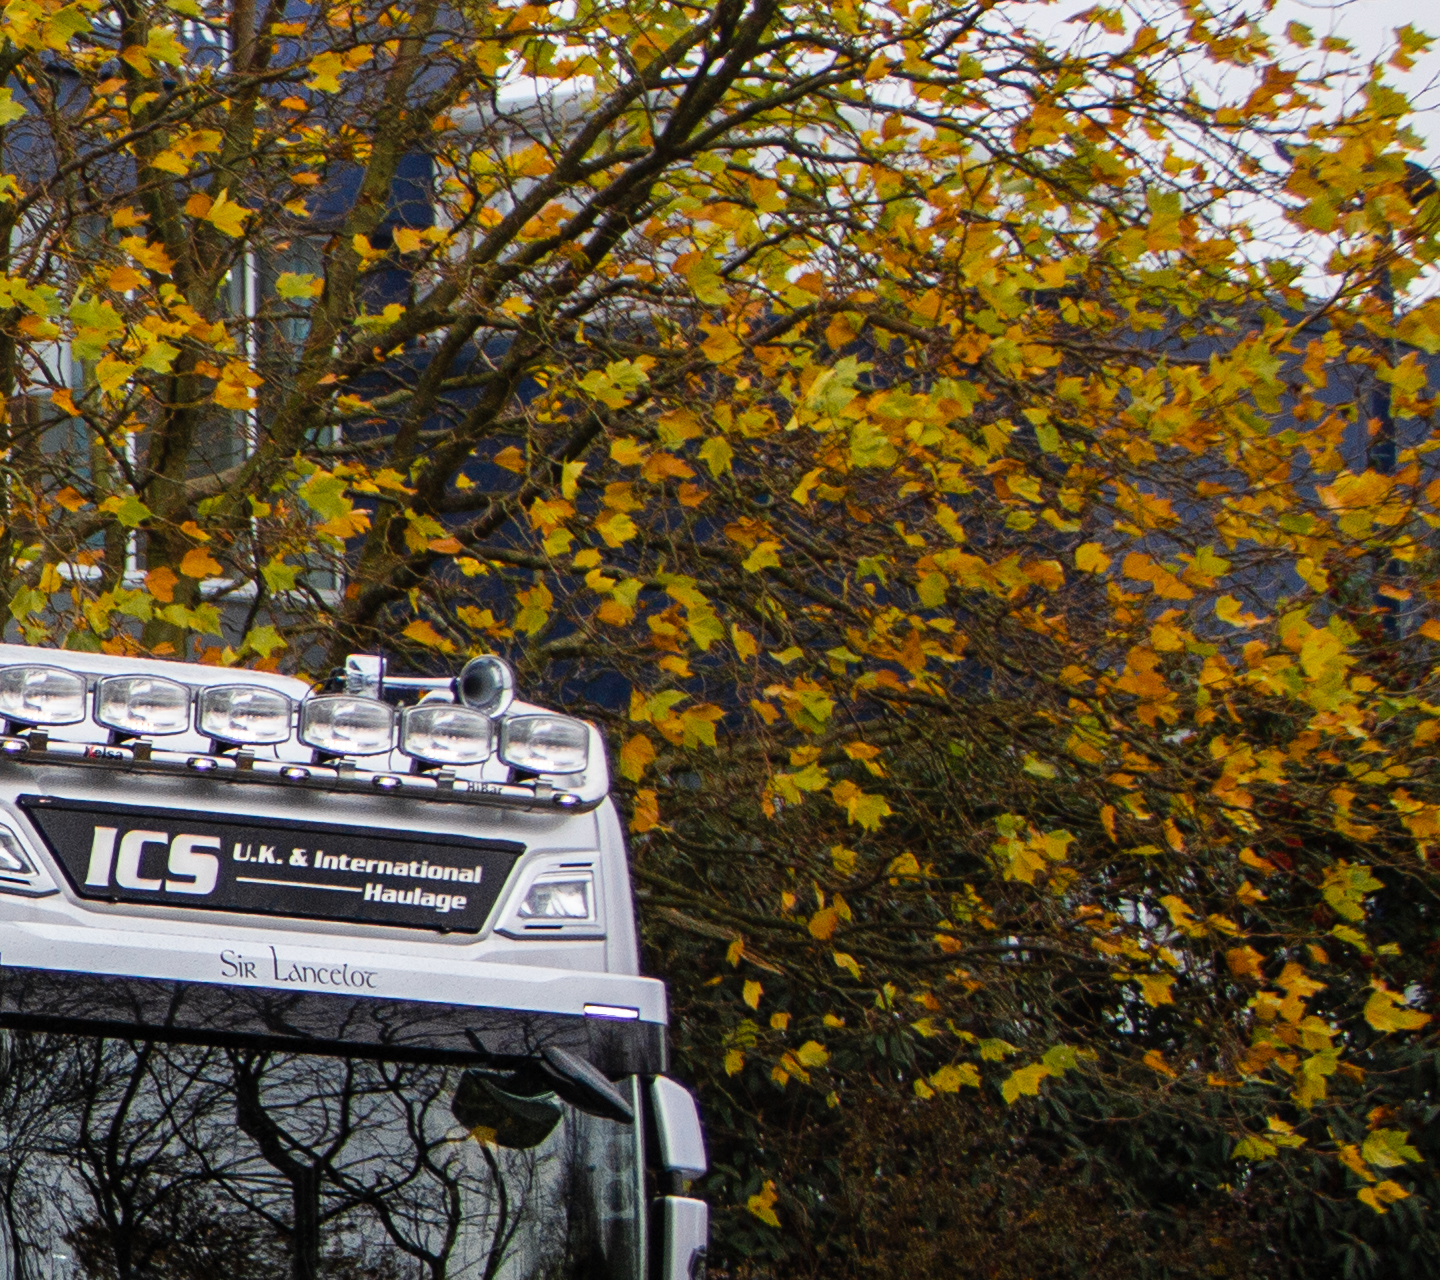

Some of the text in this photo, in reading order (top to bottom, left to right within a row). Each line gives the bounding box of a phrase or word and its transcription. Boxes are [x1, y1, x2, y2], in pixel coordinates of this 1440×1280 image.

[85, 826, 221, 895] ICS
[233, 842, 482, 884] U.K. & International
[363, 883, 467, 913] Haulage
[220, 946, 378, 989] Sir Lancelot
